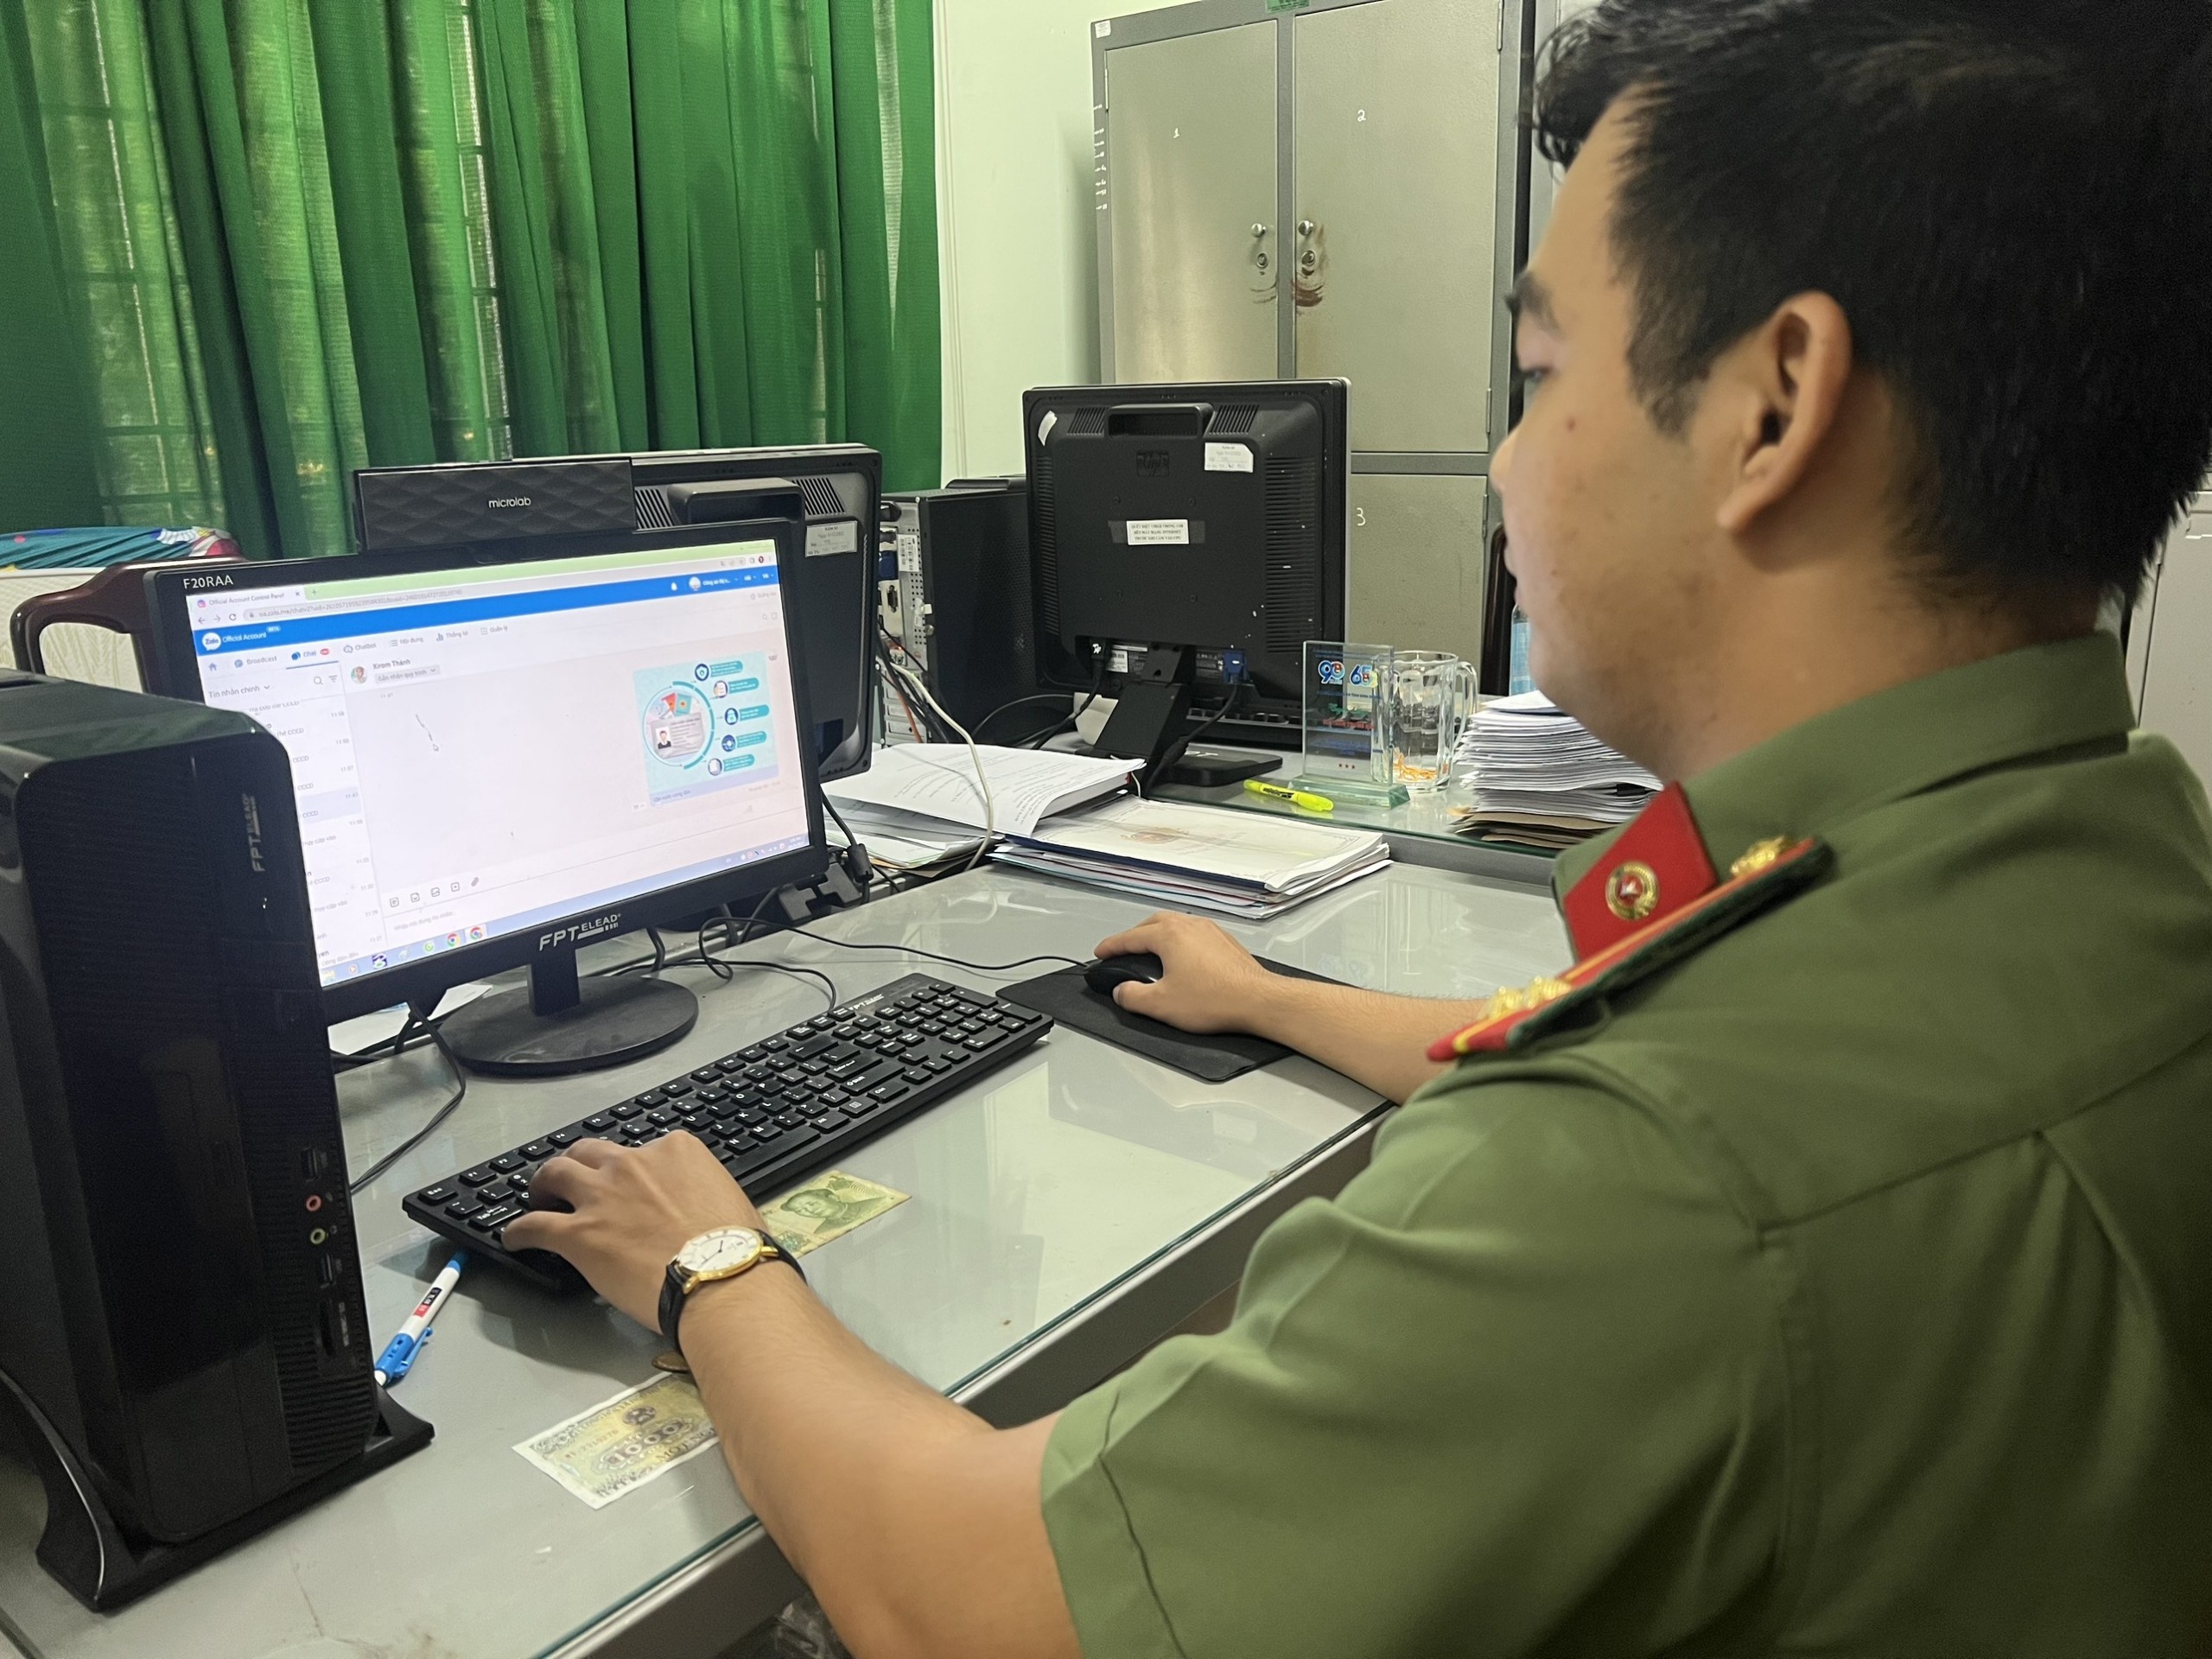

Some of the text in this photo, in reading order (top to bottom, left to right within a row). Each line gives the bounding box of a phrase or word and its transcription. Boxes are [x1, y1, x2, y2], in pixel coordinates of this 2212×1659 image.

[1357, 109, 1367, 122] 2
[1173, 127, 1180, 138] 1
[488, 496, 531, 508] microlab
[1357, 507, 1366, 526] 3
[183, 575, 234, 589] F20RAA
[222, 632, 267, 643] Official Account
[247, 656, 277, 665] Broadcast
[248, 835, 265, 871] FPT
[540, 914, 618, 951] FPT ELEAD
